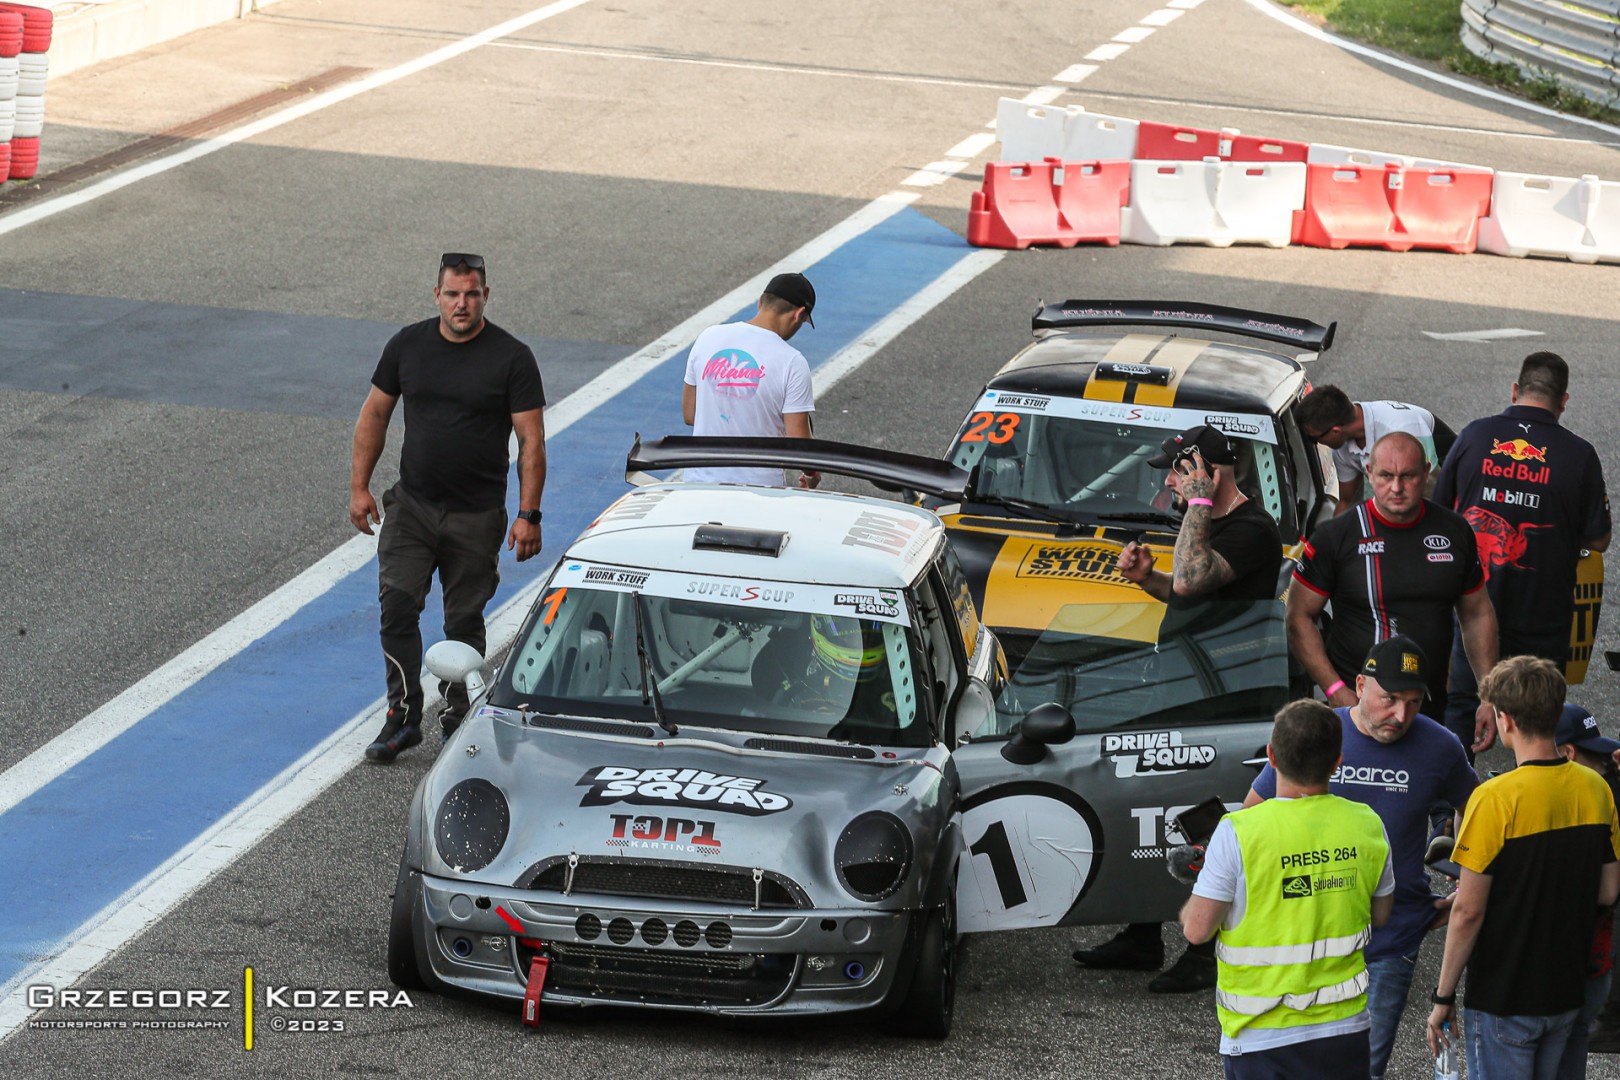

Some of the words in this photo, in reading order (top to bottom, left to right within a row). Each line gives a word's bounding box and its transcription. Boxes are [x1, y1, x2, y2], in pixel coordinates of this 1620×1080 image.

[702, 356, 766, 381] Miami
[997, 396, 1021, 406] WORK
[1023, 398, 1050, 408] STUFF
[1081, 404, 1126, 419] SUPER
[1143, 411, 1172, 424] CUP
[1206, 416, 1238, 426] DRIVE
[961, 411, 1021, 445] 23
[1225, 423, 1260, 434] SQUAD
[1482, 458, 1516, 479] Red
[1516, 463, 1551, 485] Bull
[1482, 486, 1524, 505] Mobil
[1358, 540, 1385, 555] RACE
[1426, 536, 1449, 548] KIA
[1030, 557, 1122, 576] STUF
[1038, 549, 1120, 566] WOR
[584, 570, 614, 582] WORK
[617, 574, 649, 586] STUFF
[687, 580, 742, 599] SUPER
[761, 589, 795, 604] CUP
[836, 594, 875, 605] DRIVE
[543, 587, 568, 625] 1
[858, 603, 900, 617] SQUAD
[1105, 733, 1169, 752] DRIVE
[1142, 745, 1217, 767] SQUAD
[594, 766, 763, 790] DRIVE
[600, 780, 790, 811] SQUAD
[609, 813, 722, 847] TOP1
[630, 840, 696, 852] KARTING
[969, 820, 1028, 910] 1
[1281, 849, 1330, 869] PRESS
[1333, 846, 1357, 862] 264
